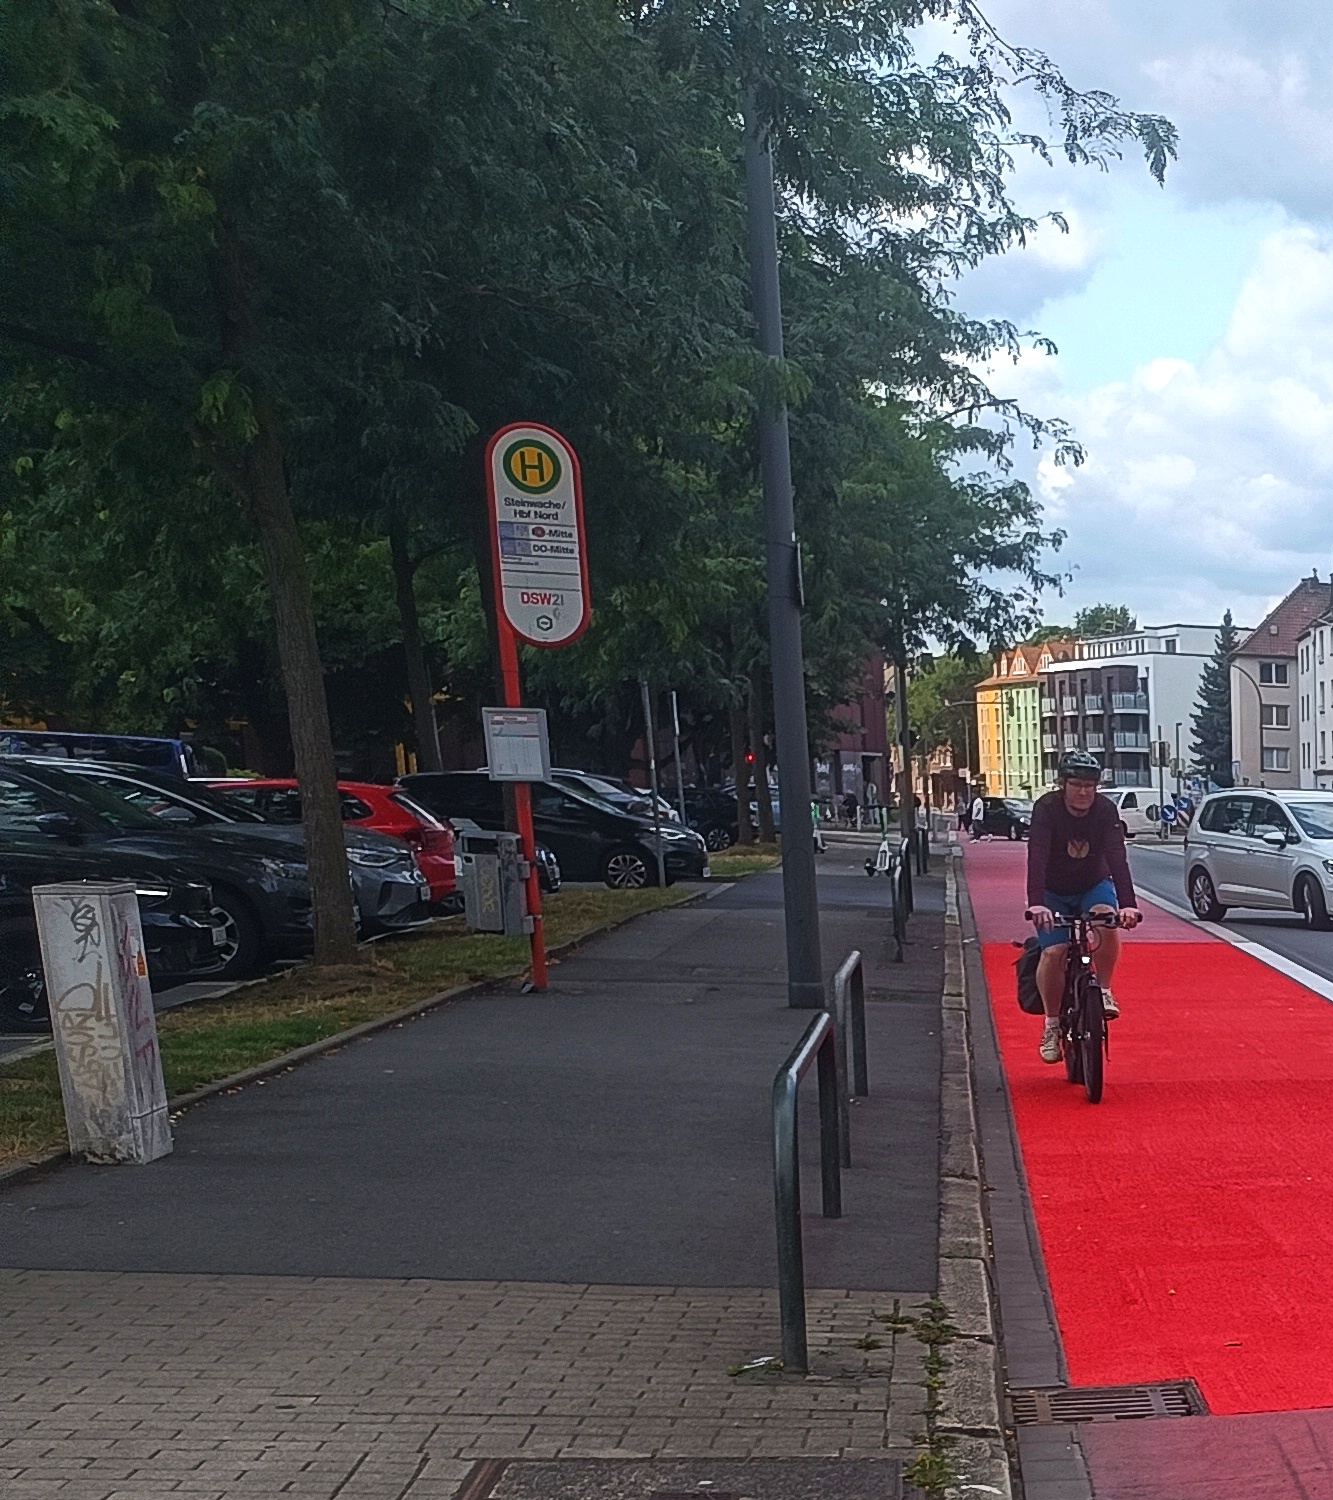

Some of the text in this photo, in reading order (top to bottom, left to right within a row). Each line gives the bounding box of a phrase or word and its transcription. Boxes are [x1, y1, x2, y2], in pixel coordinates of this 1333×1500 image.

[518, 450, 545, 482] H
[503, 496, 567, 510] Steinwache/
[513, 508, 559, 521] Hbf Nord
[520, 591, 565, 606] DSW21
